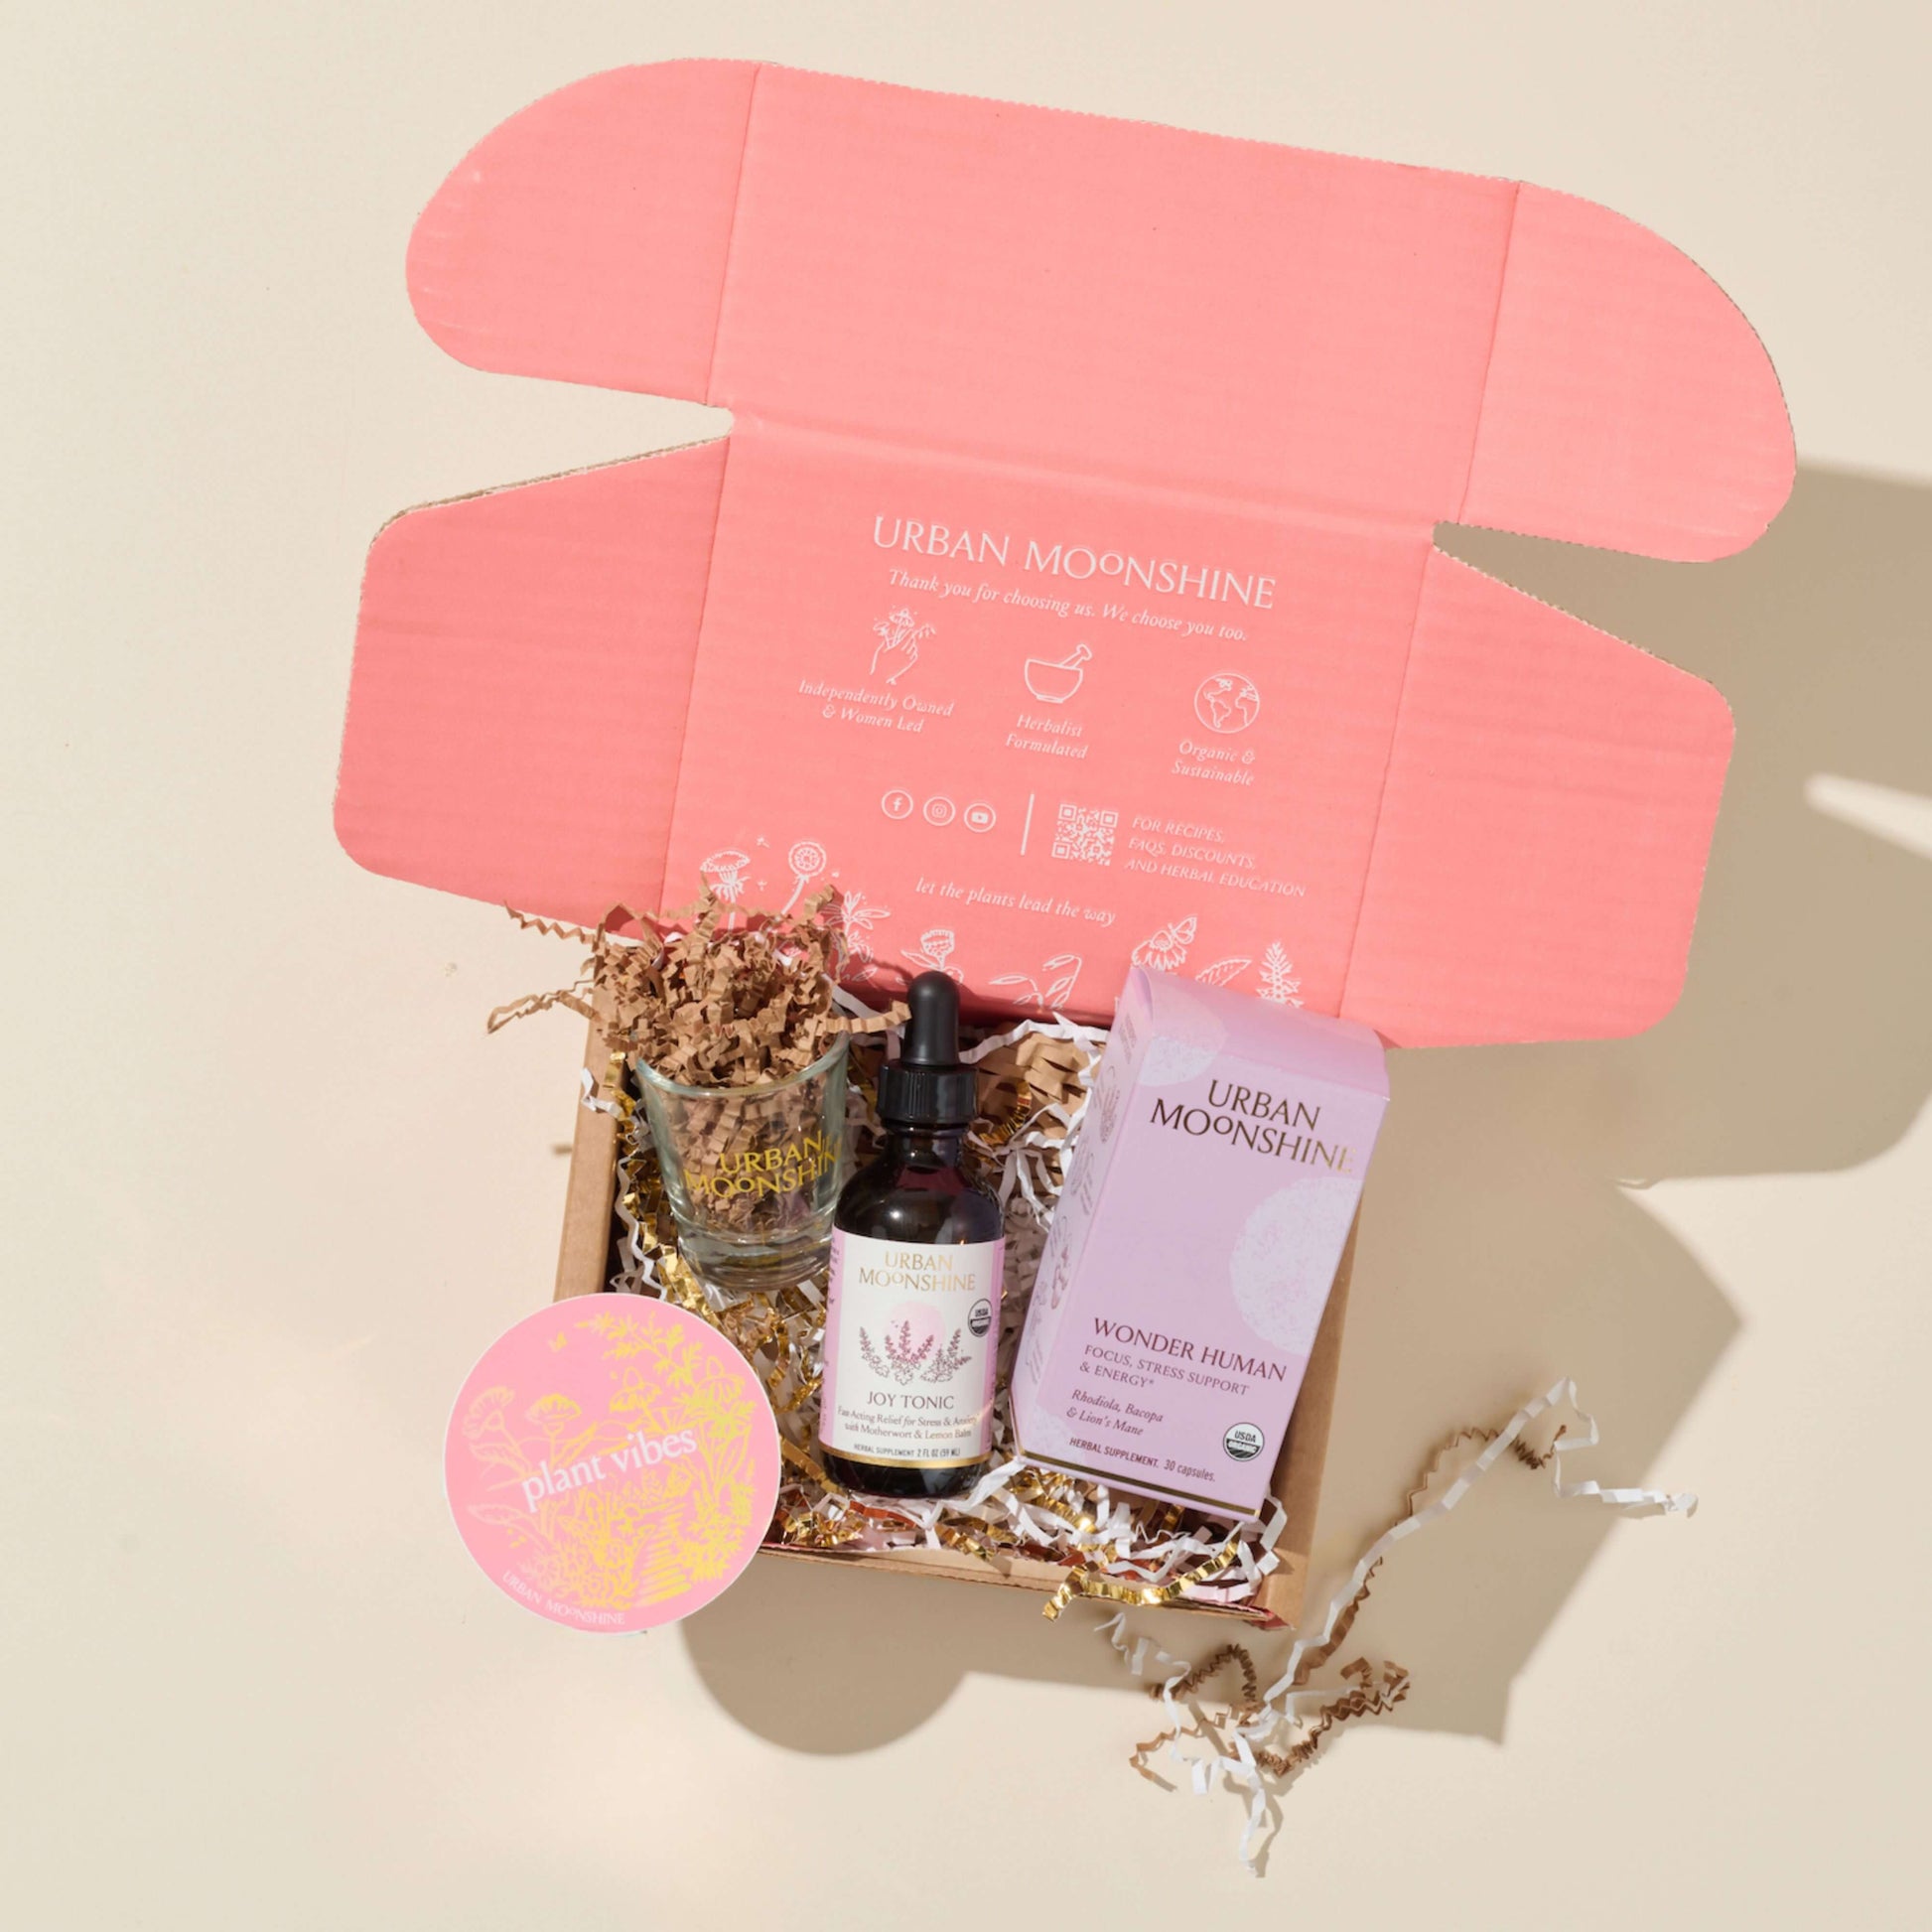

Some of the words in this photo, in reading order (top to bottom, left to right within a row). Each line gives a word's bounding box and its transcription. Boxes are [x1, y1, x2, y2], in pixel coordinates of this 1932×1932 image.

[874, 515, 1010, 567] URBAN
[1025, 540, 1276, 609] MOONSHINE
[890, 569, 939, 591] Thank
[939, 584, 971, 598] you
[973, 583, 999, 603] for
[1004, 589, 1070, 618] choosing
[1074, 604, 1096, 617] us.
[1103, 604, 1128, 621] We
[1132, 611, 1181, 630] choose
[1181, 624, 1213, 636] you
[1218, 626, 1247, 640] too.
[799, 679, 897, 711] Independently
[902, 695, 954, 716] Owned
[823, 704, 835, 718] &
[841, 707, 893, 728] Women
[897, 716, 924, 733] Led
[1017, 714, 1082, 738] Herbalist
[1006, 734, 1088, 759] Formulated
[1179, 739, 1236, 762] Organic
[1242, 750, 1255, 764] &
[1172, 759, 1255, 786] Sustainable
[1132, 816, 1161, 832] FOR
[1165, 819, 1224, 843] RECIPES,
[1172, 844, 1255, 870] DISCOUNTS,
[1125, 859, 1158, 874] AND
[1161, 863, 1214, 884] HERBAL
[1219, 874, 1306, 897] EDUCATION
[915, 877, 935, 895] let
[940, 882, 963, 898] the
[966, 887, 1016, 905] plants
[1019, 894, 1053, 913] lead
[1055, 901, 1079, 917] the
[1083, 908, 1116, 927] way
[1208, 1079, 1320, 1131] URBAN
[1150, 1098, 1357, 1173] MOONSHINE
[684, 1135, 841, 1198] MOONSHIN
[720, 1130, 822, 1174] URBAN
[885, 1251, 953, 1272] URBAN
[859, 1267, 976, 1292] MOONSHINE
[1094, 1317, 1194, 1361] WONDER
[1200, 1346, 1287, 1382] HUMAN
[1079, 1361, 1091, 1374] &
[1084, 1344, 1133, 1368] FOCUS,
[1137, 1358, 1184, 1380] STRESS
[1187, 1372, 1250, 1396] SUPPORT
[867, 1391, 897, 1406] JOY
[900, 1395, 954, 1410] TONIC
[1071, 1389, 1121, 1413] Rhodiola,
[1125, 1403, 1164, 1423] Bacopa
[861, 1424, 911, 1439] Motherwort
[913, 1430, 922, 1439] &
[925, 1430, 953, 1439] Lemon
[955, 1429, 972, 1438] Balm
[878, 1414, 904, 1426] Relief
[902, 1415, 916, 1429] for
[943, 1417, 951, 1426] &
[1066, 1406, 1078, 1418] &
[1079, 1408, 1111, 1429] Lion's
[1113, 1419, 1144, 1436] Mane
[876, 1447, 914, 1456] SUPPLEMENT
[1234, 1430, 1256, 1443] USDA
[522, 1453, 606, 1513] plant
[611, 1428, 698, 1473] vibes
[1069, 1438, 1102, 1453] HERBAL
[1104, 1446, 1160, 1468] SUPPLEMENT.
[1164, 1458, 1176, 1471] 30
[1176, 1462, 1215, 1482] capsules.
[502, 1571, 542, 1604] URBAN
[545, 1599, 625, 1625] MOONSHINE
